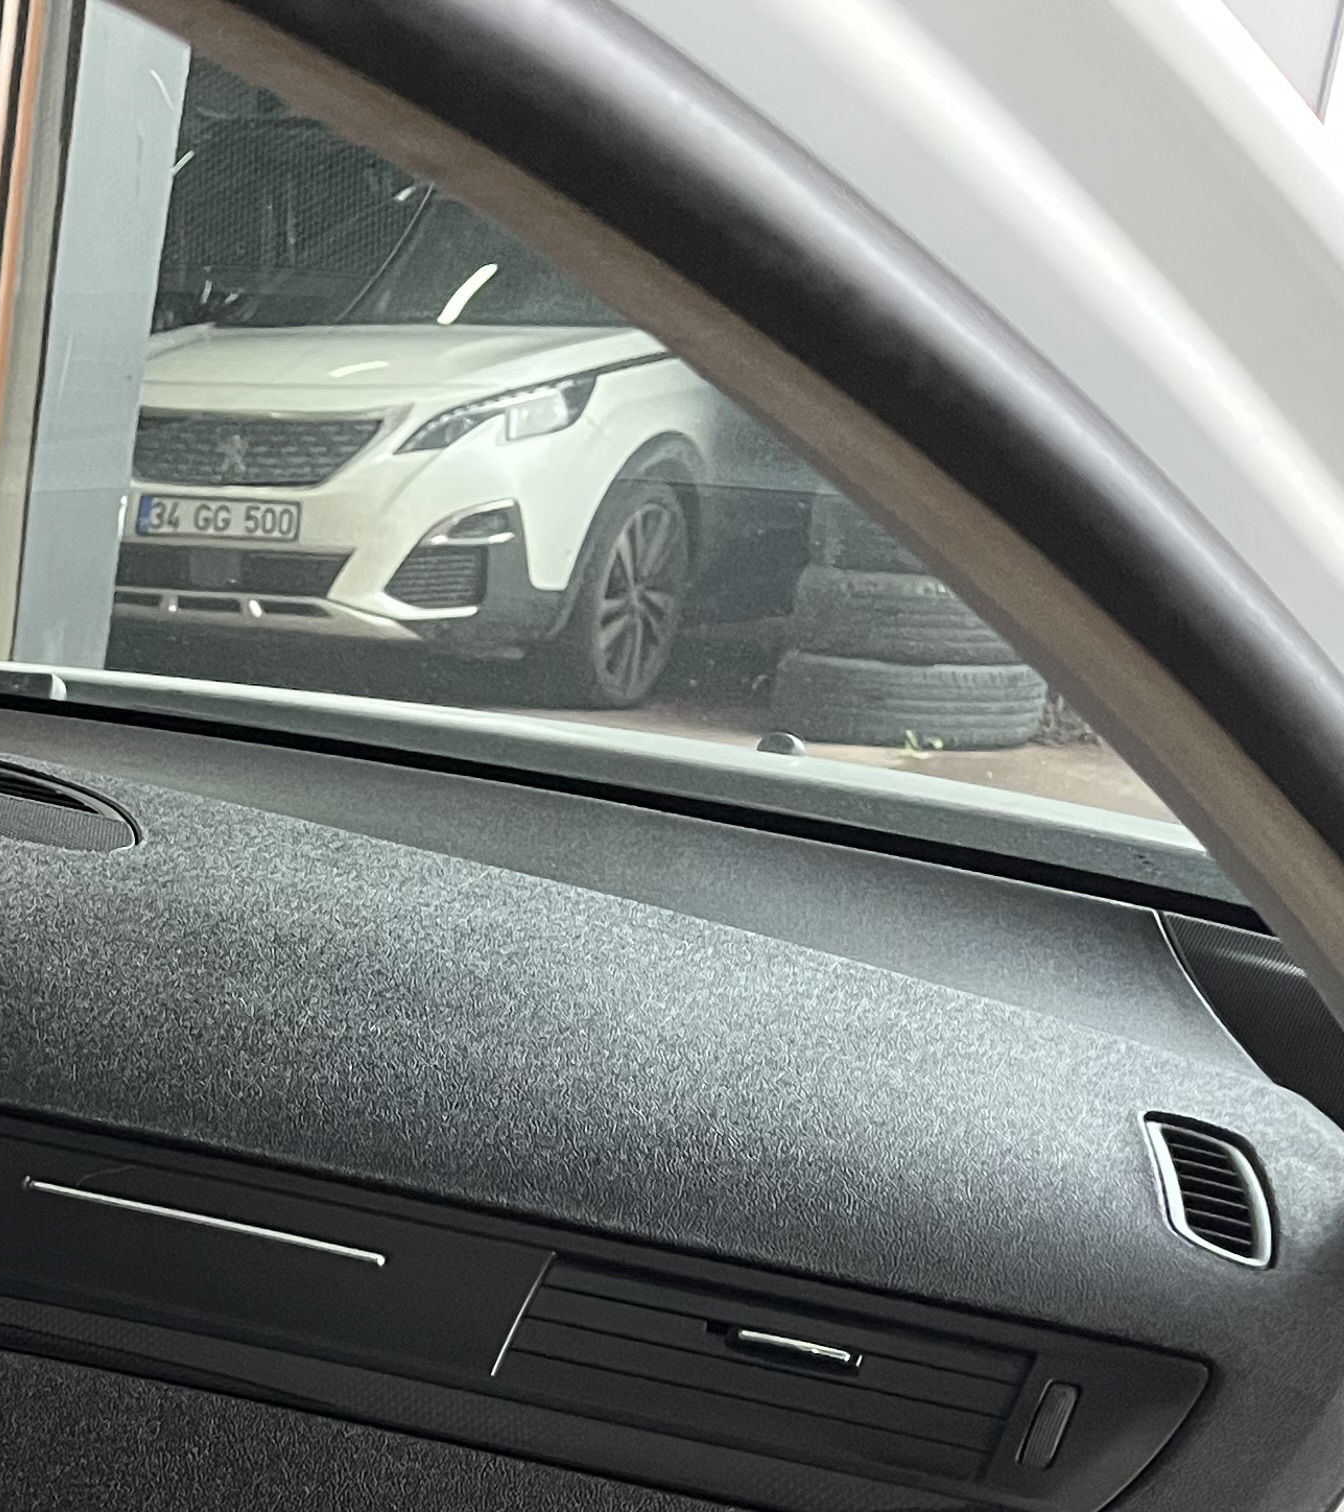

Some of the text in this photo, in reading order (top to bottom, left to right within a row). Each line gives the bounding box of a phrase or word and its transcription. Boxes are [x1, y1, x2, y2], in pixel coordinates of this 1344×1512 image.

[148, 501, 294, 535] 34 GG 500
